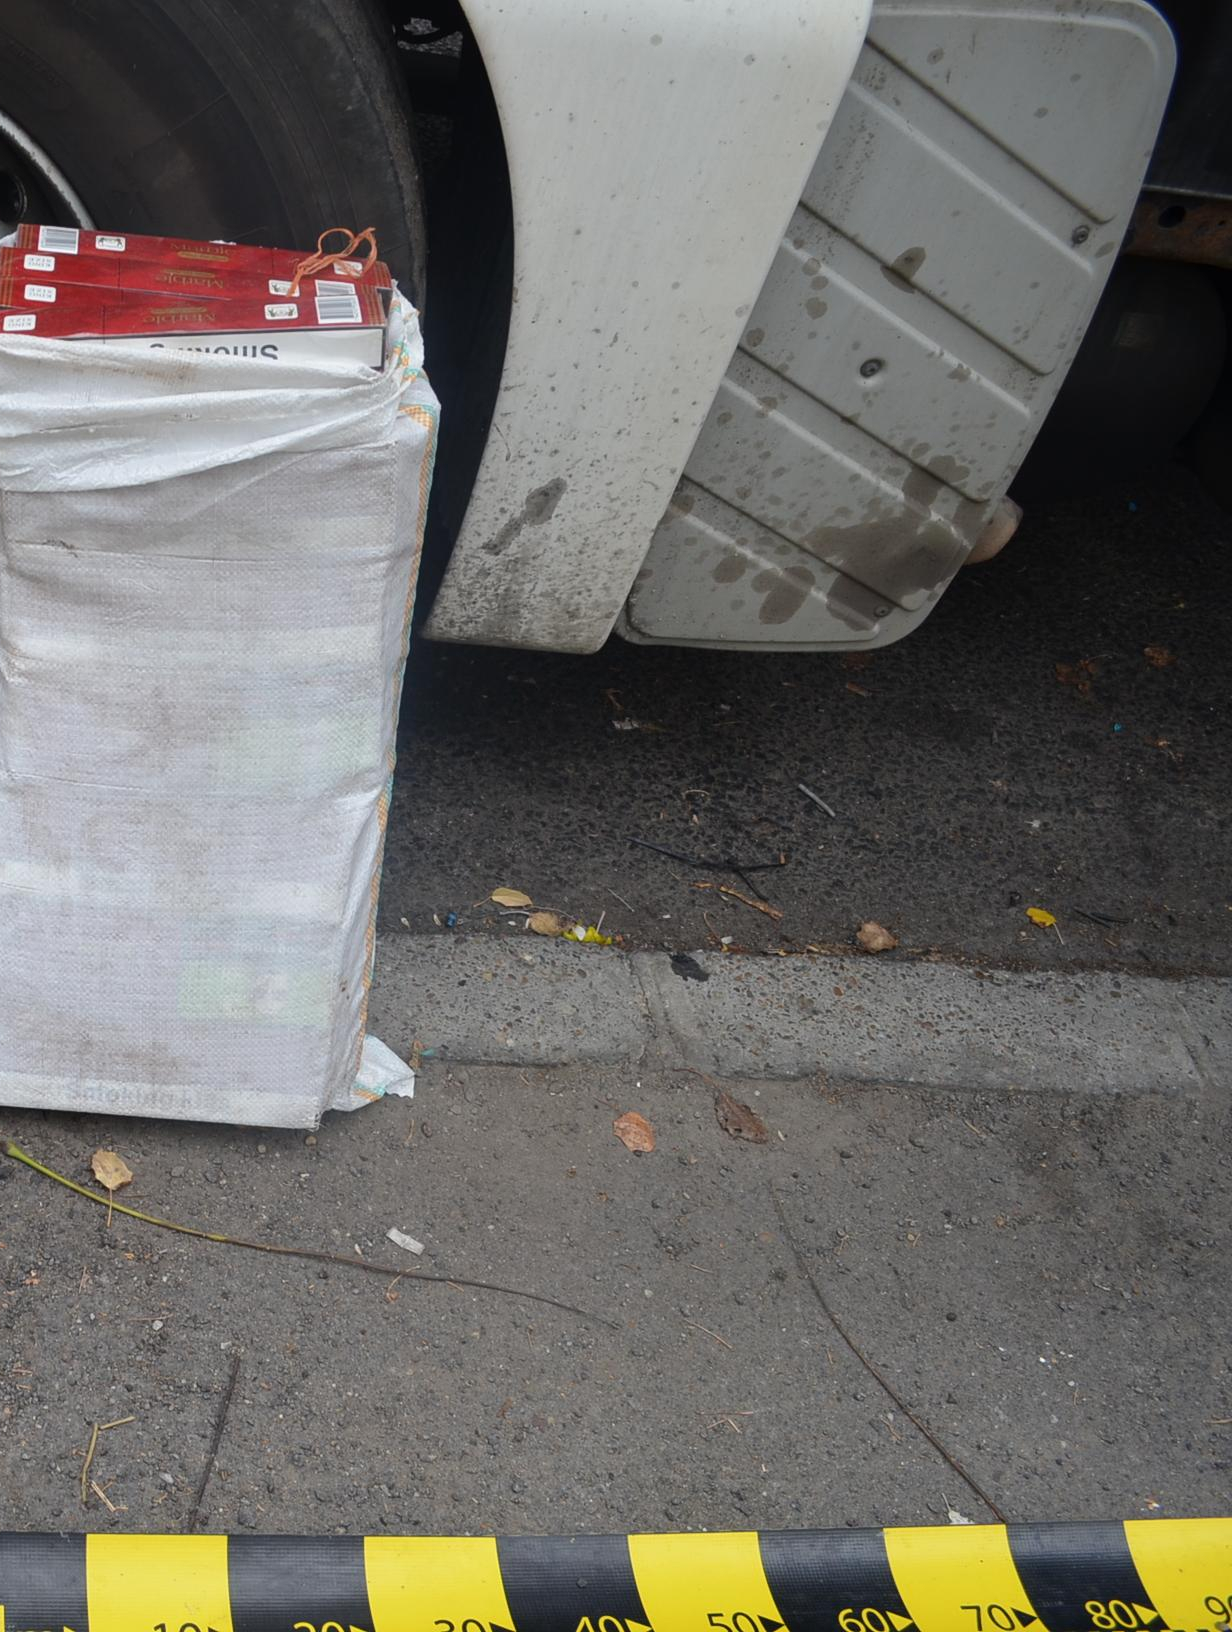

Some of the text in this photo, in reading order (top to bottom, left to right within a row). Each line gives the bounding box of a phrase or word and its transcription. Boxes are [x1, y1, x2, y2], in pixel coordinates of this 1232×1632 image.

[706, 1611, 759, 1632] 50
[837, 1607, 891, 1632] 60
[959, 1603, 1016, 1632] 70
[1084, 1599, 1139, 1629] 80
[1203, 1595, 1232, 1626] 9
